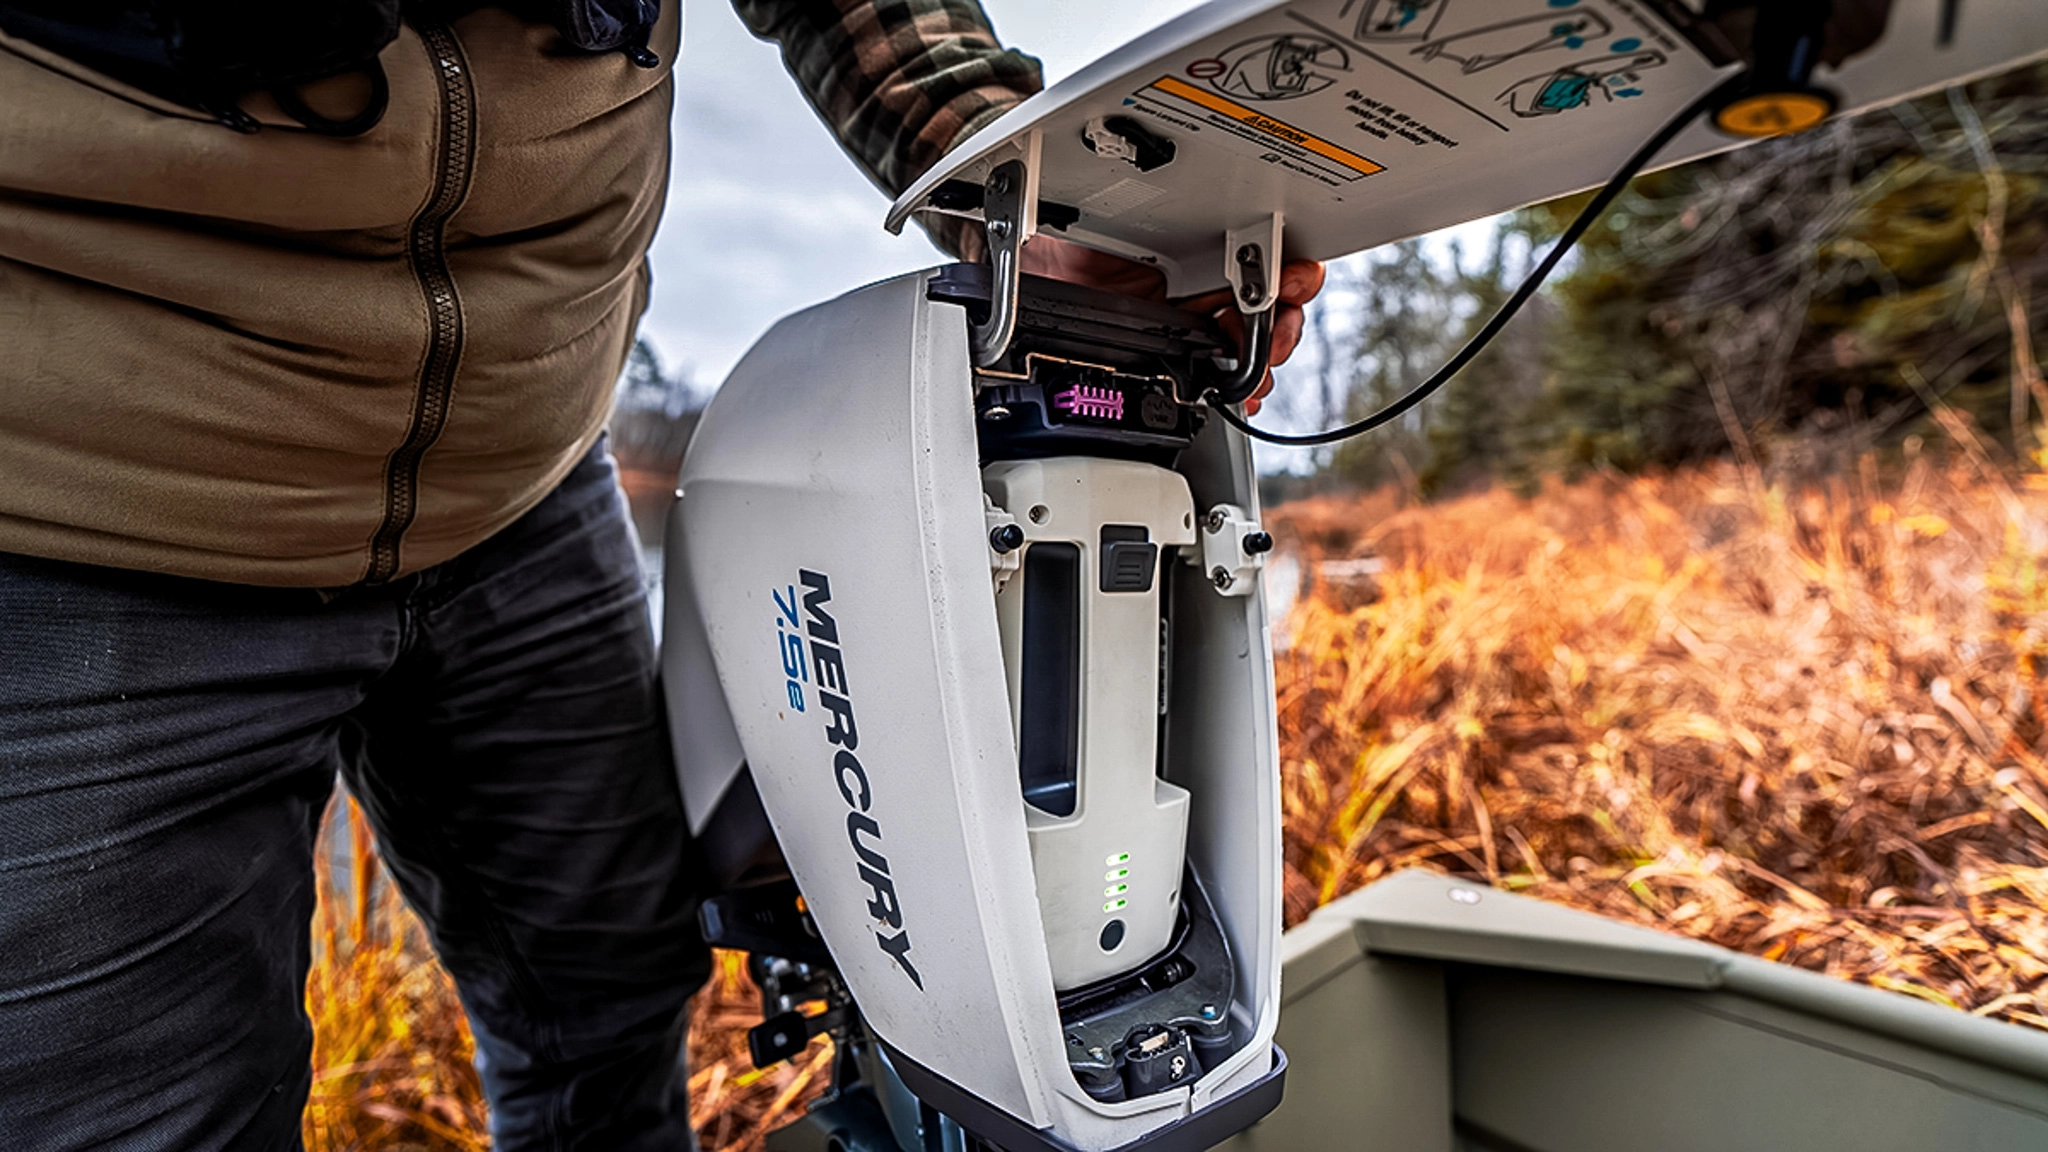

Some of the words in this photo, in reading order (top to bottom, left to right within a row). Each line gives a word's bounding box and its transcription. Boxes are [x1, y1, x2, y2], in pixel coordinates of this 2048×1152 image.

[1257, 120, 1309, 143] CAUTION
[1395, 128, 1429, 145] battery
[1416, 125, 1459, 149] transport
[773, 585, 808, 713] 7.5e
[799, 568, 924, 992] MERCURY
